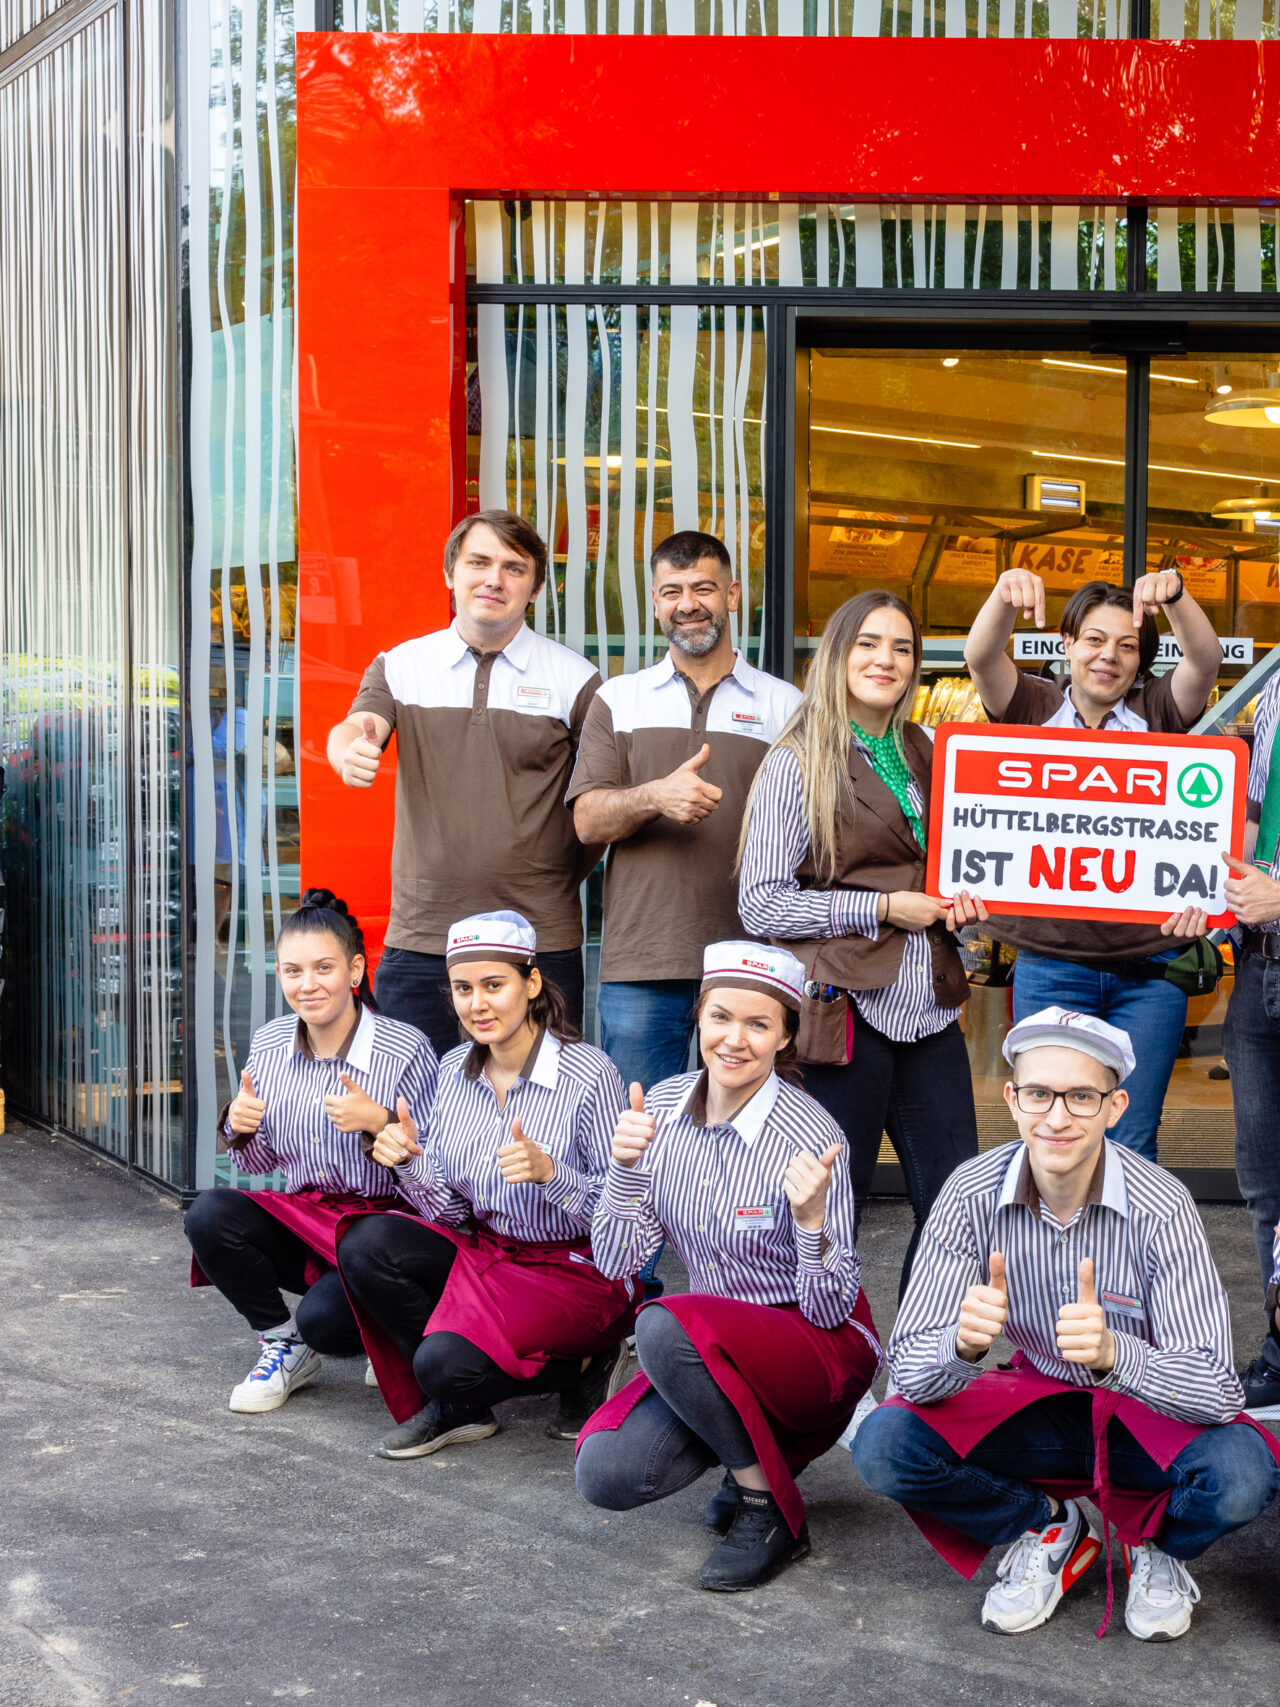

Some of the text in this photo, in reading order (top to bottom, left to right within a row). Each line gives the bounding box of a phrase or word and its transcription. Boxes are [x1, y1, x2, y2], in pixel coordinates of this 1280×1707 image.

[998, 760, 1162, 797] SPAR
[953, 803, 1219, 842] HÜTTELBERGSTRASSE
[951, 844, 1218, 899] IST NEU DA!
[747, 960, 768, 971] SPAR
